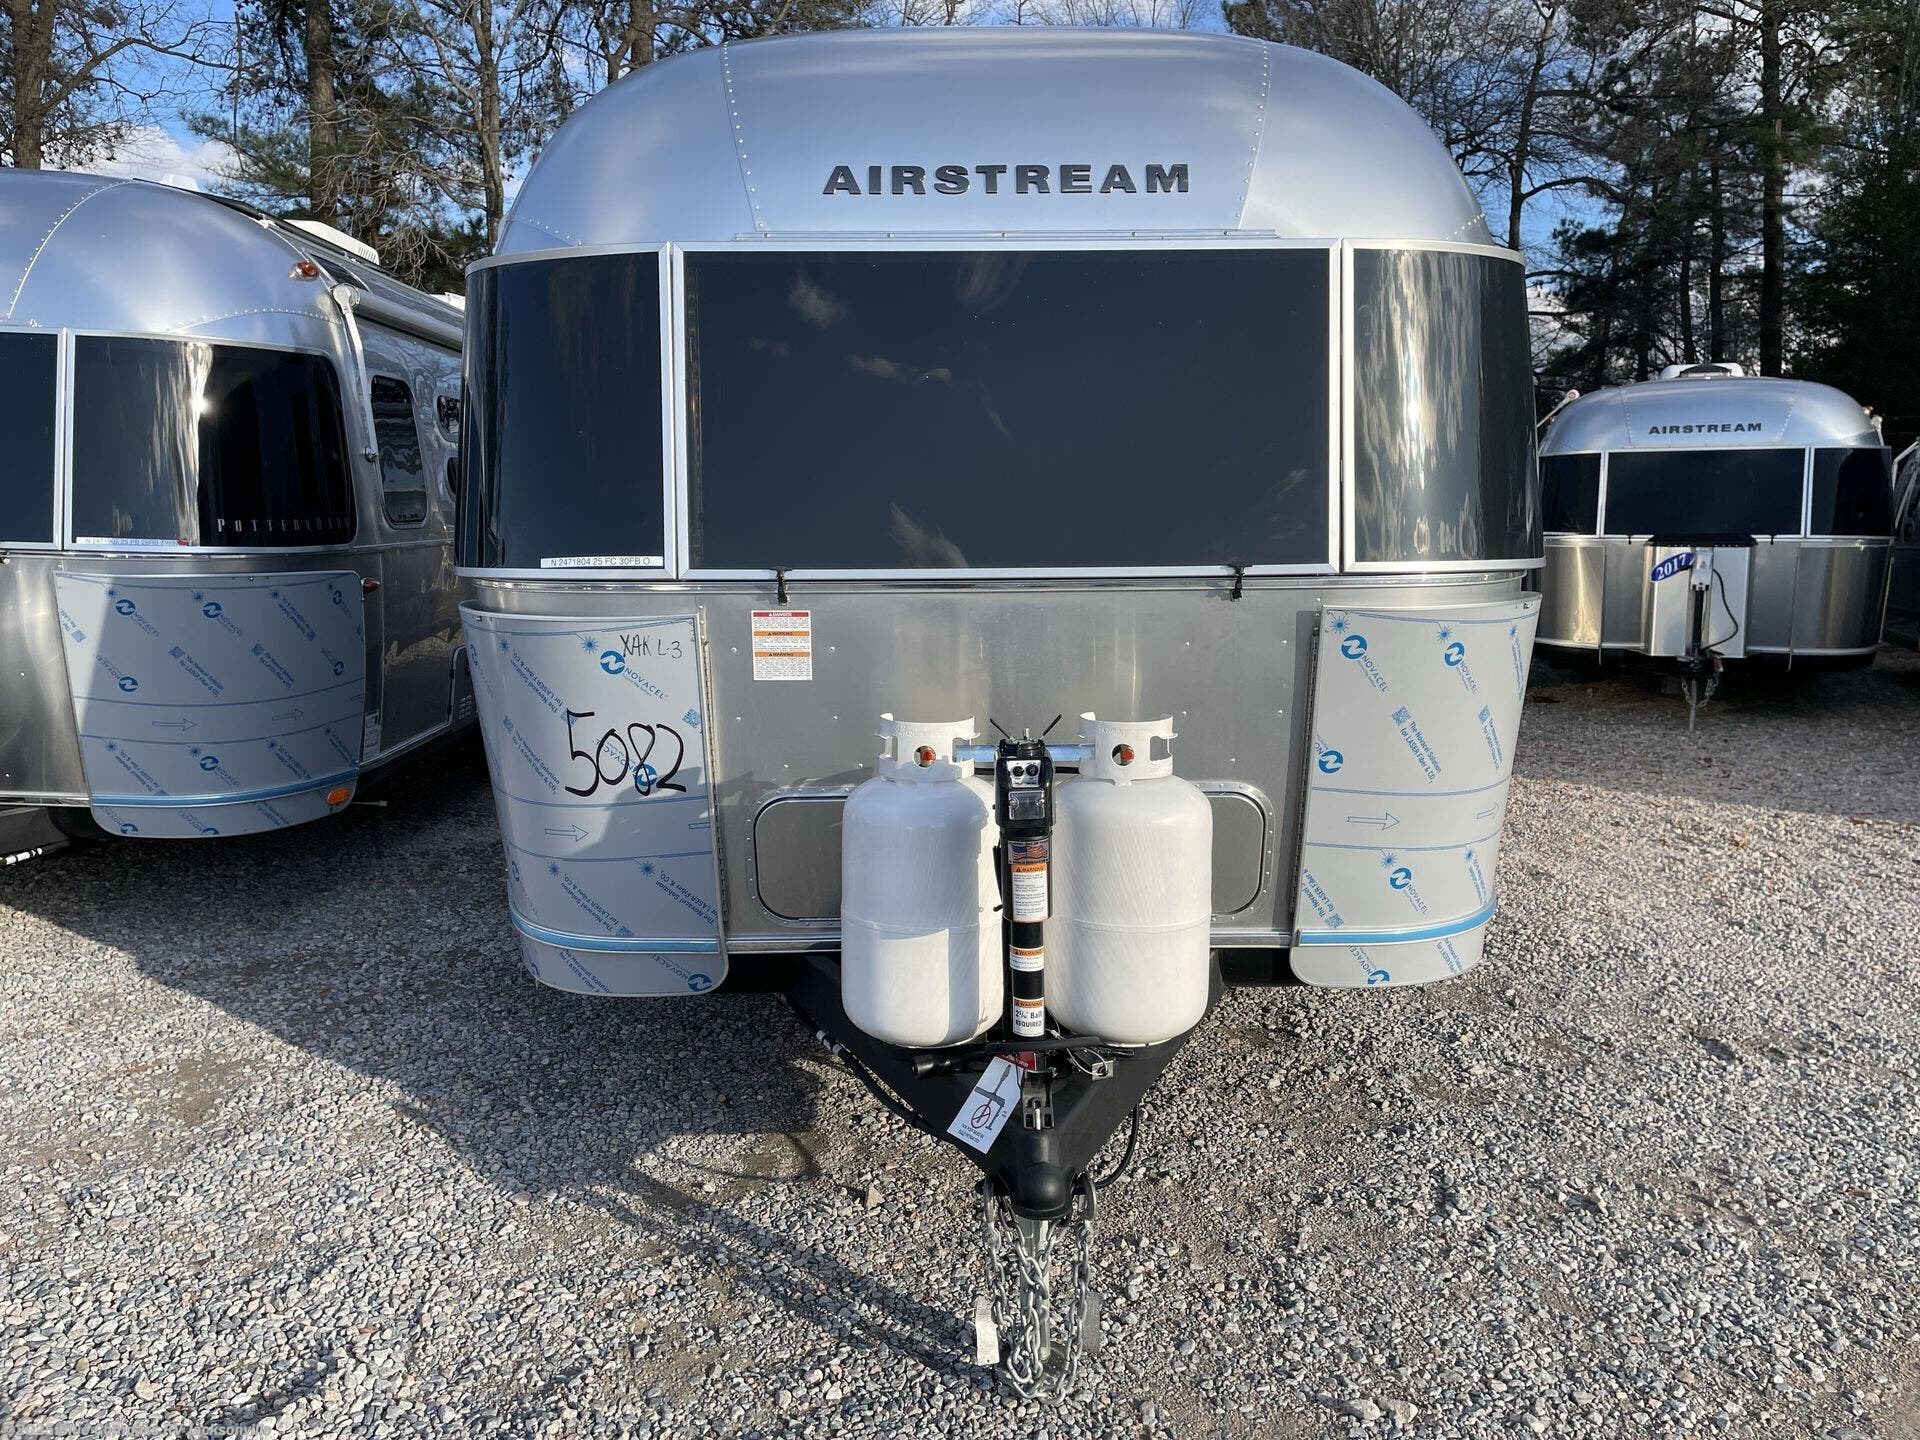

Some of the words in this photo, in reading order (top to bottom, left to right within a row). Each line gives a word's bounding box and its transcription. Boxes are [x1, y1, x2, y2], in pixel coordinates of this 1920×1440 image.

[822, 163, 1190, 195] AIRSTREAM
[1648, 422, 1762, 435] AIRSTREAM
[559, 558, 591, 566] 2471804
[593, 557, 603, 565] 25
[604, 557, 617, 565] FC
[619, 557, 640, 565] 30FB
[1656, 553, 1687, 580] 2017
[624, 667, 665, 699] NOVACEL
[1361, 655, 1388, 693] NOVACEL
[1458, 661, 1478, 695] NOVACEL
[536, 680, 555, 699] LASER
[565, 708, 687, 797] 5082
[1406, 736, 1420, 756] LASER
[540, 761, 560, 785] Solution
[690, 896, 712, 912] LASER
[1406, 884, 1429, 915] NOVACEL
[652, 953, 689, 980] NOVACEL
[1015, 1019, 1042, 1028] REQUIRED
[1030, 1010, 1043, 1019] Ball
